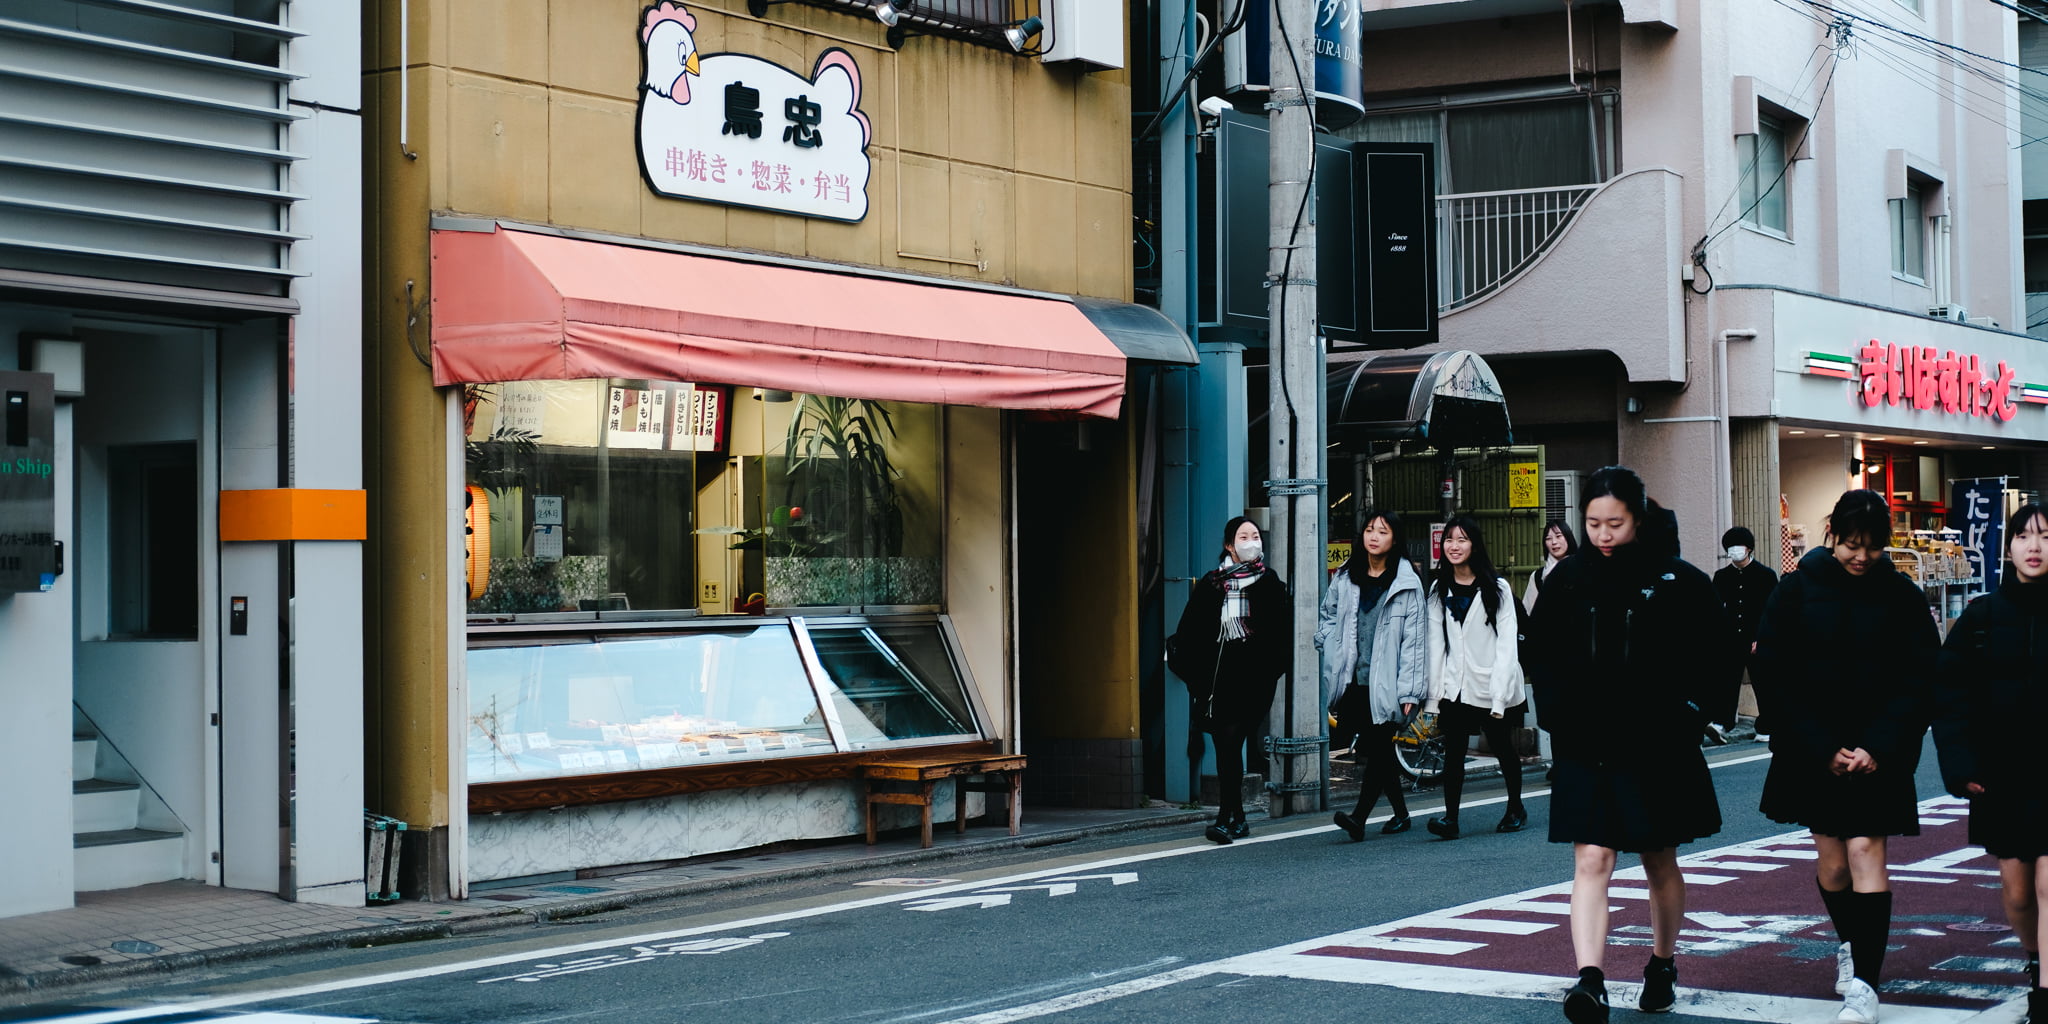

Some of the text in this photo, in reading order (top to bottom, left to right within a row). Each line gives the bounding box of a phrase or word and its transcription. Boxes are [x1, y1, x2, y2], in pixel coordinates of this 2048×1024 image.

[1314, 38, 1341, 58] URA
[722, 81, 824, 149] 鳥忠
[665, 146, 851, 203] 串焼き・惣菜・弁当
[676, 392, 686, 435] やきとり
[16, 458, 52, 478] Ship
